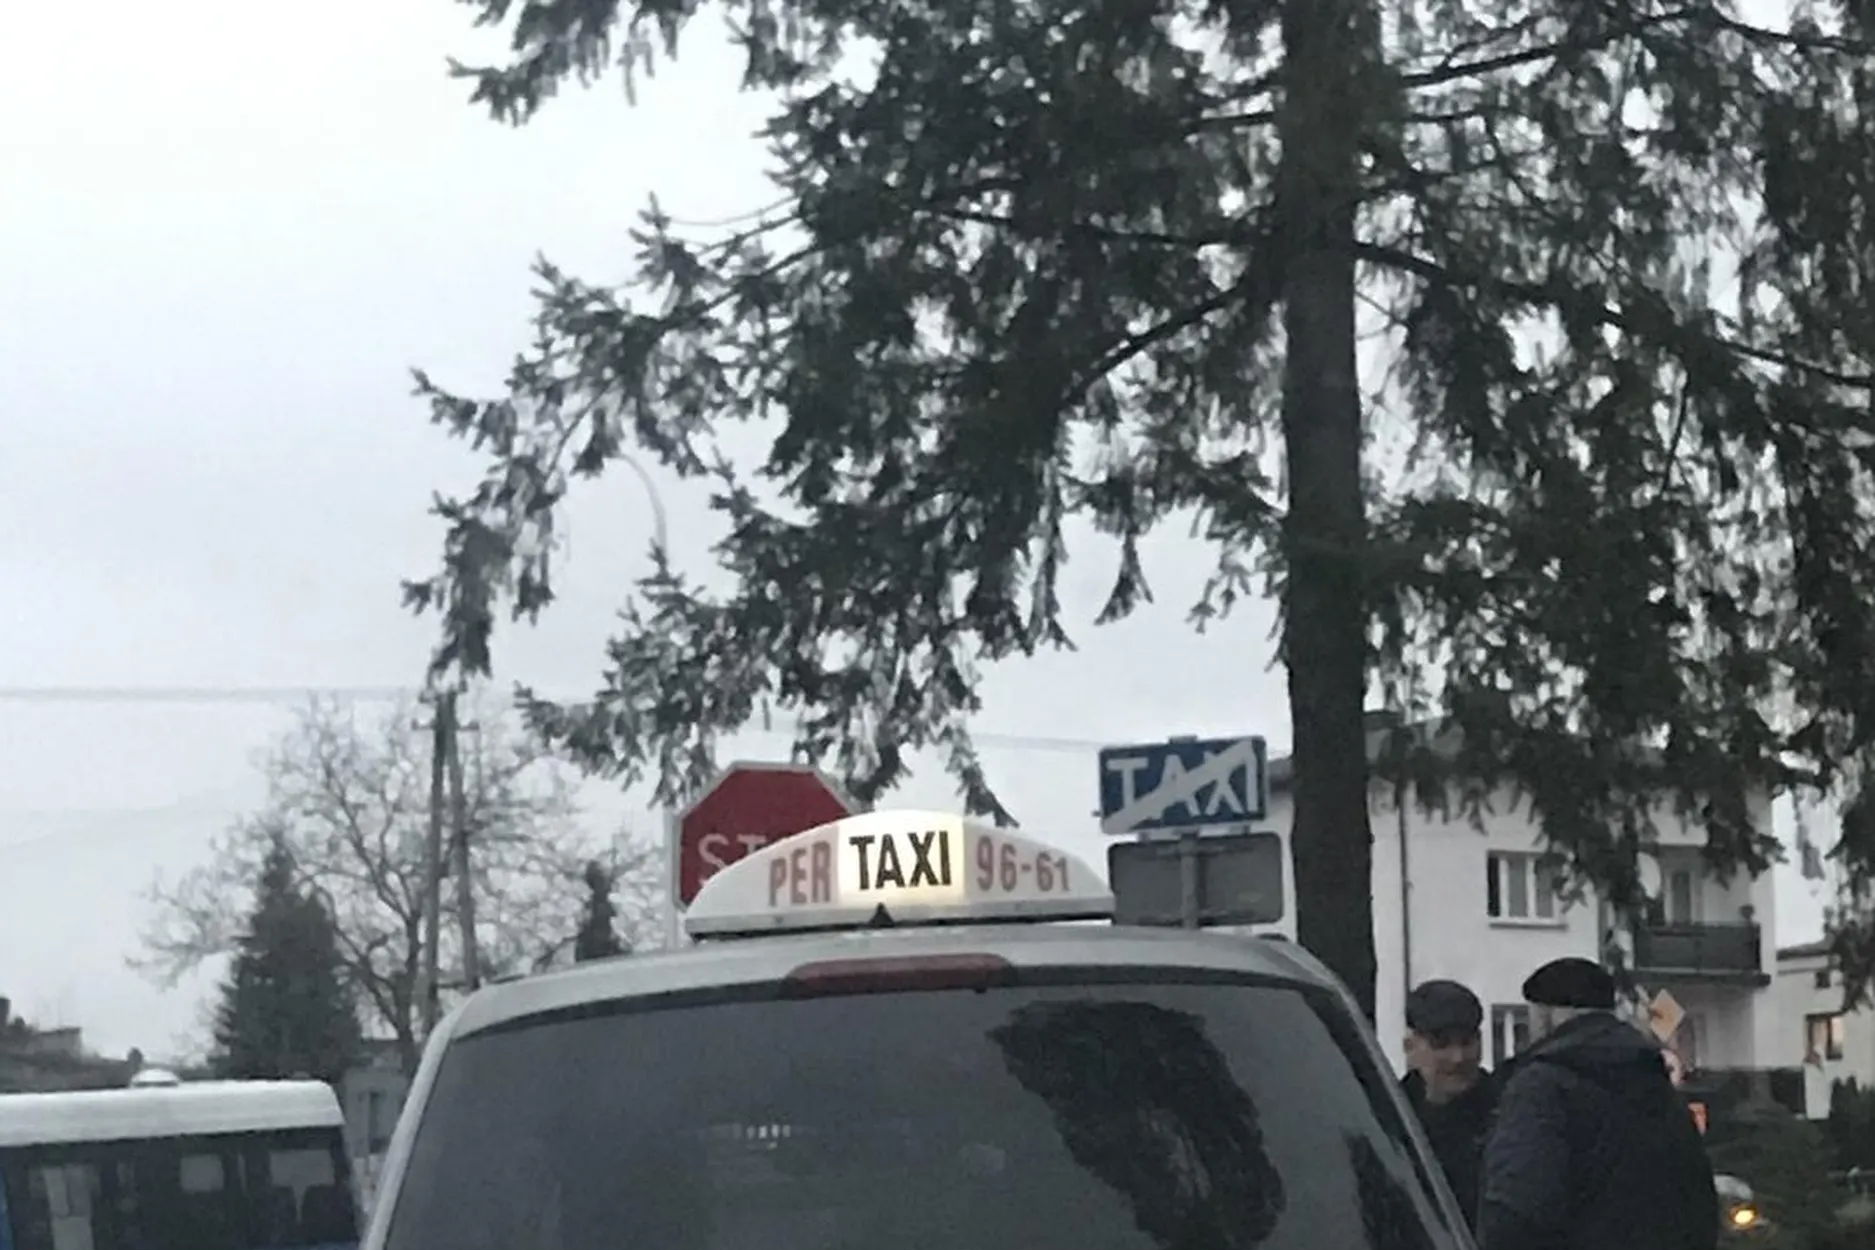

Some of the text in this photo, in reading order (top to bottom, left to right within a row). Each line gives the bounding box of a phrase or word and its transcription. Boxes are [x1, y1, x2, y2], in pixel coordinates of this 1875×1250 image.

[1106, 741, 1259, 820] TAXI
[698, 833, 767, 886] ST
[769, 829, 1070, 907] PER TAXI 96-61
